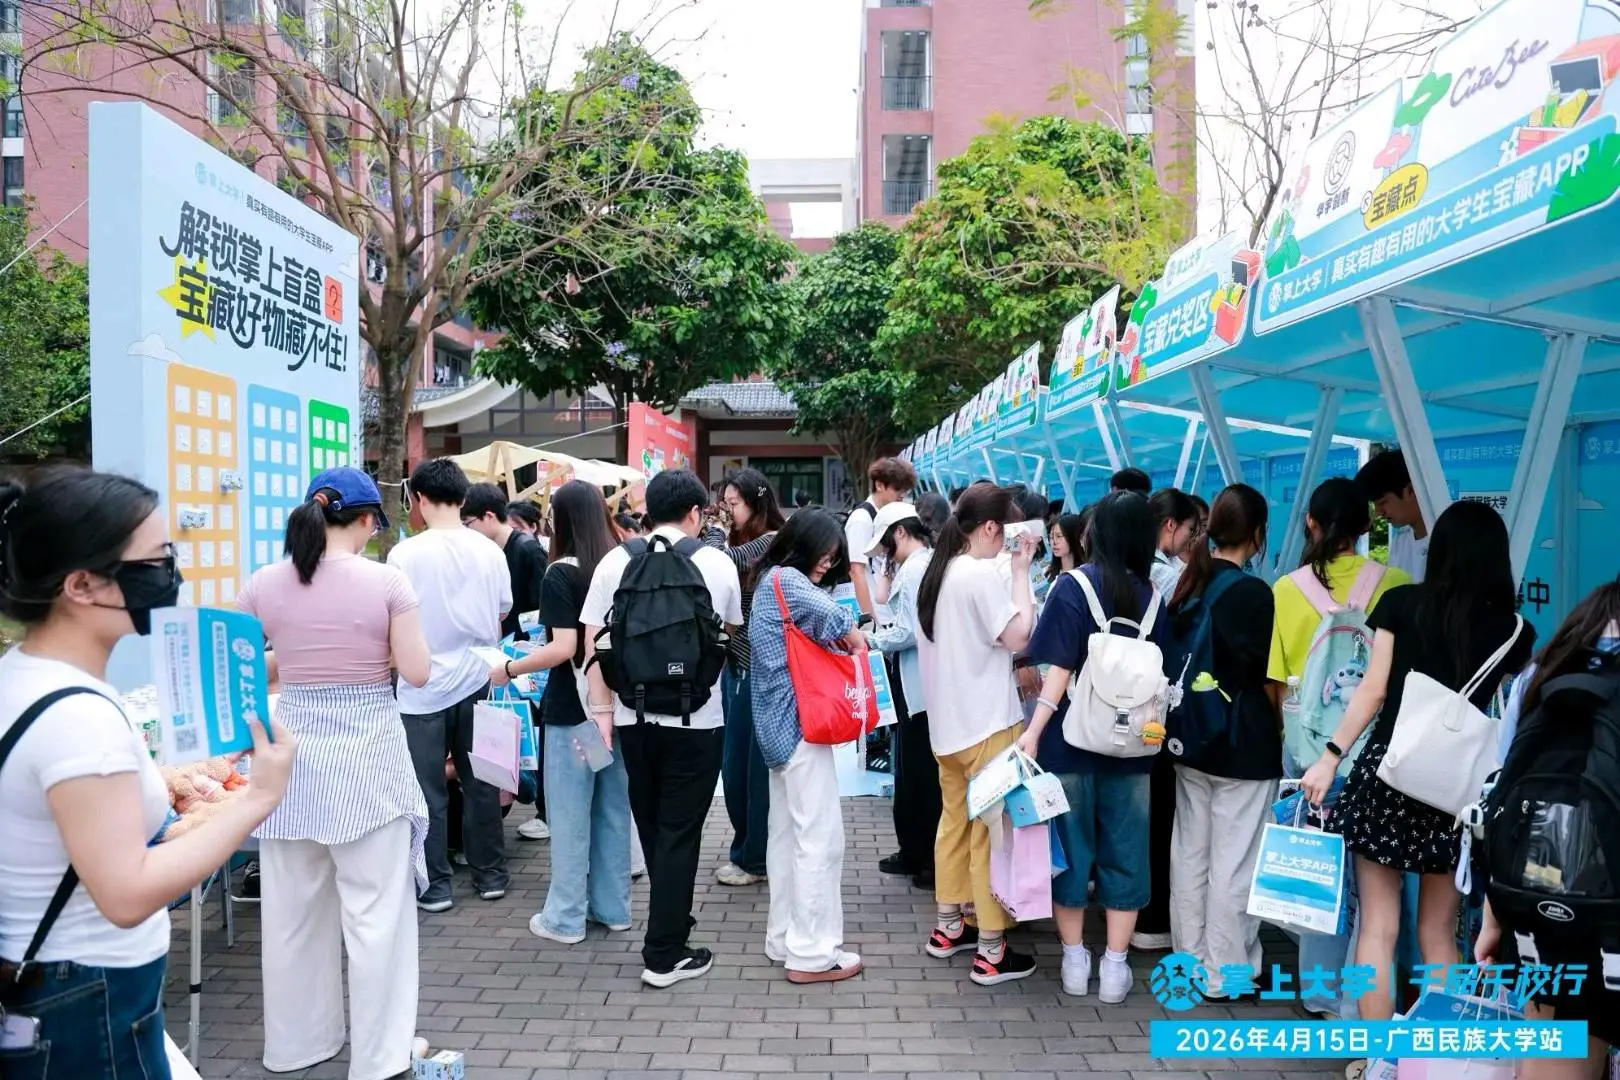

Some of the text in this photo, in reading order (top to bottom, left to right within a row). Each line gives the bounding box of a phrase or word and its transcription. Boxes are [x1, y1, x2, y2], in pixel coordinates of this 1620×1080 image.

[1450, 38, 1550, 108] CuteBee
[1371, 174, 1419, 223] 宝藏点
[159, 200, 322, 316] 解锁掌上盲盒
[1143, 289, 1212, 355] 宝藏兑奖区
